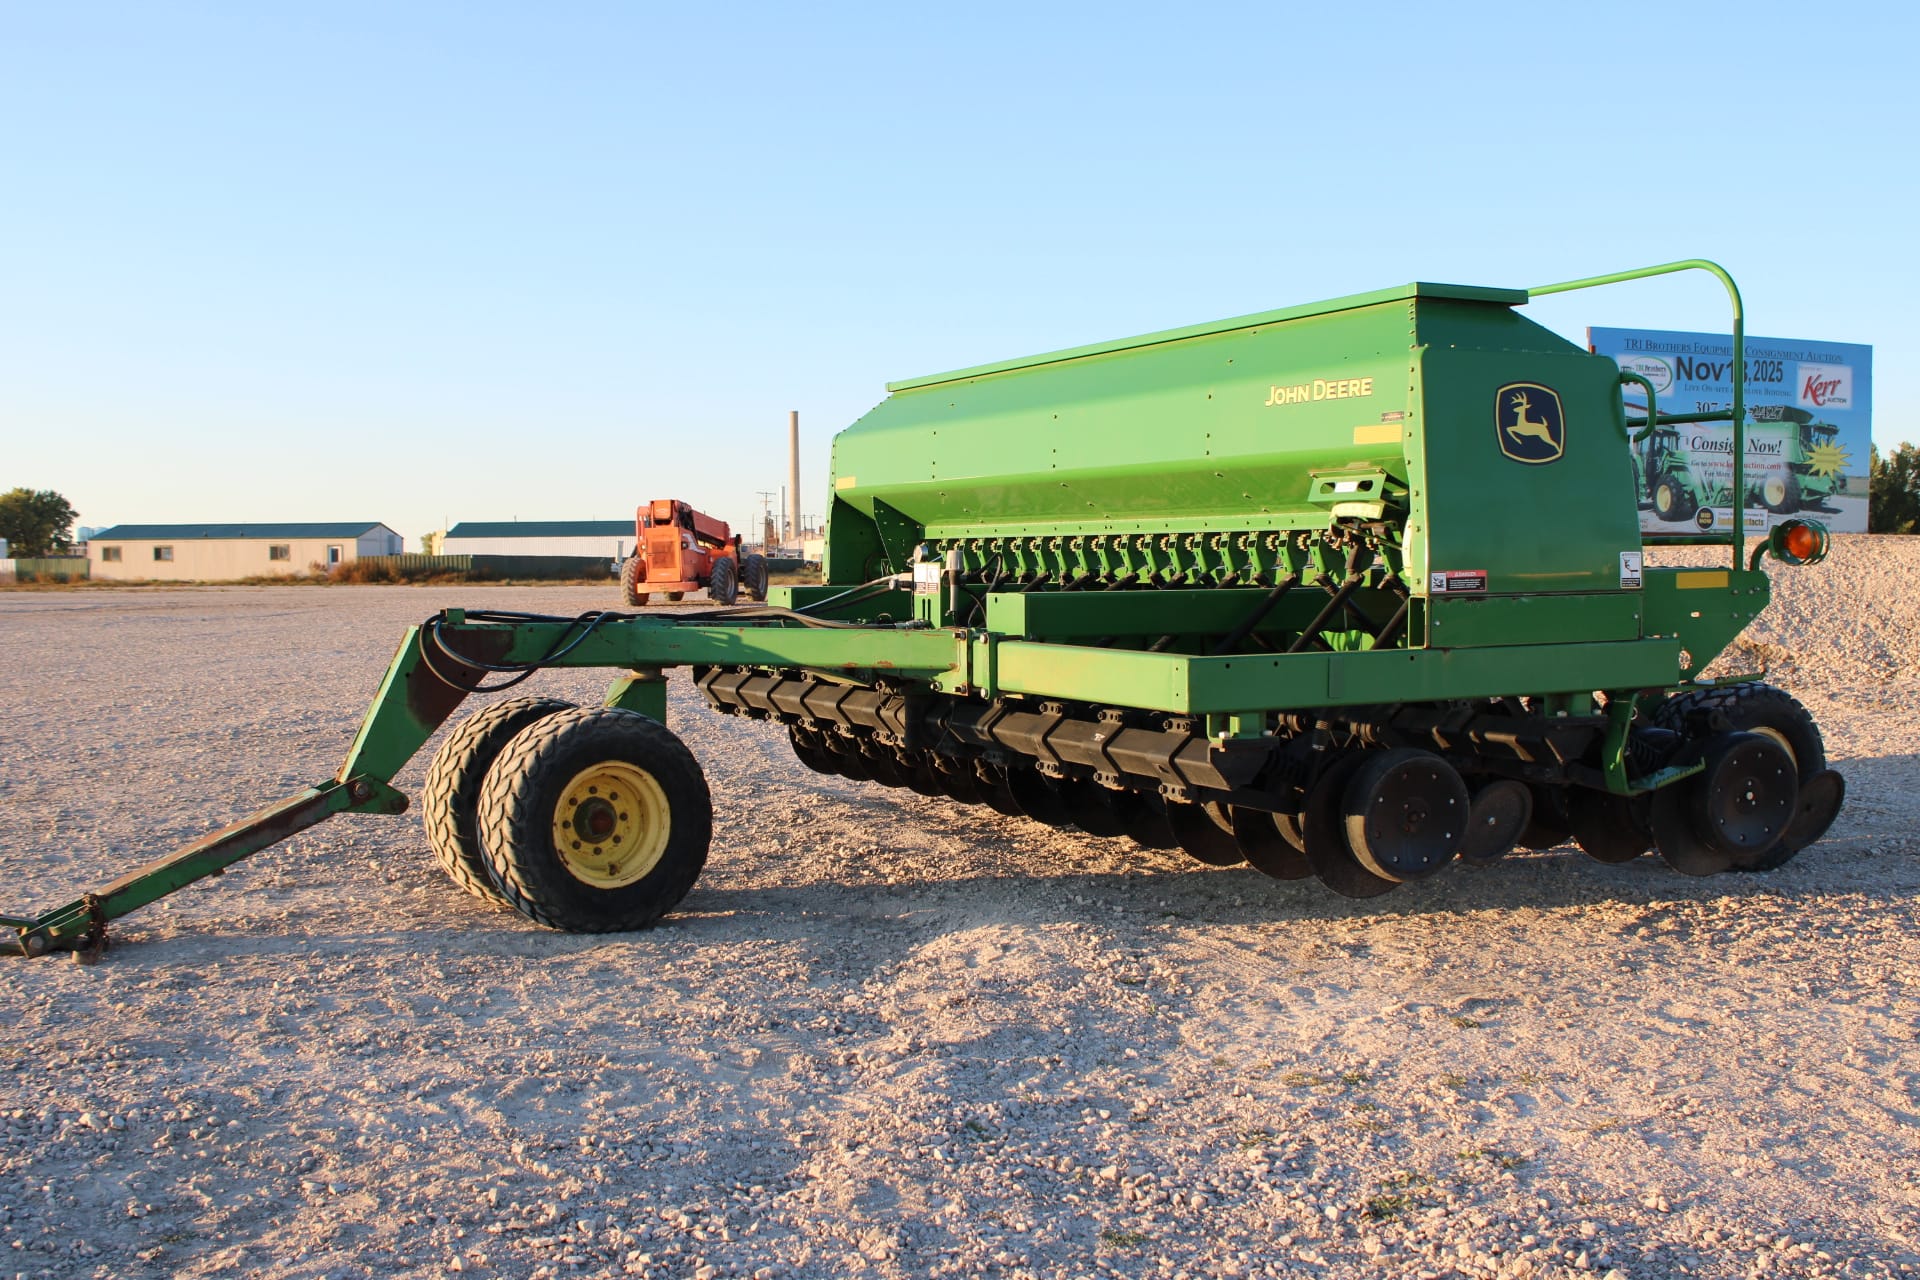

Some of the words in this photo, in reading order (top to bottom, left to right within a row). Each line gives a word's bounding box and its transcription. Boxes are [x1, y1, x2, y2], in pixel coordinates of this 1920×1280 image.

[1625, 338, 1642, 350] TRI
[1265, 384, 1310, 407] JOHN
[1313, 377, 1373, 401] DEERE
[1802, 374, 1841, 406] Kerr
[1691, 435, 1735, 456] Consig
[1748, 438, 1782, 454] Now!
